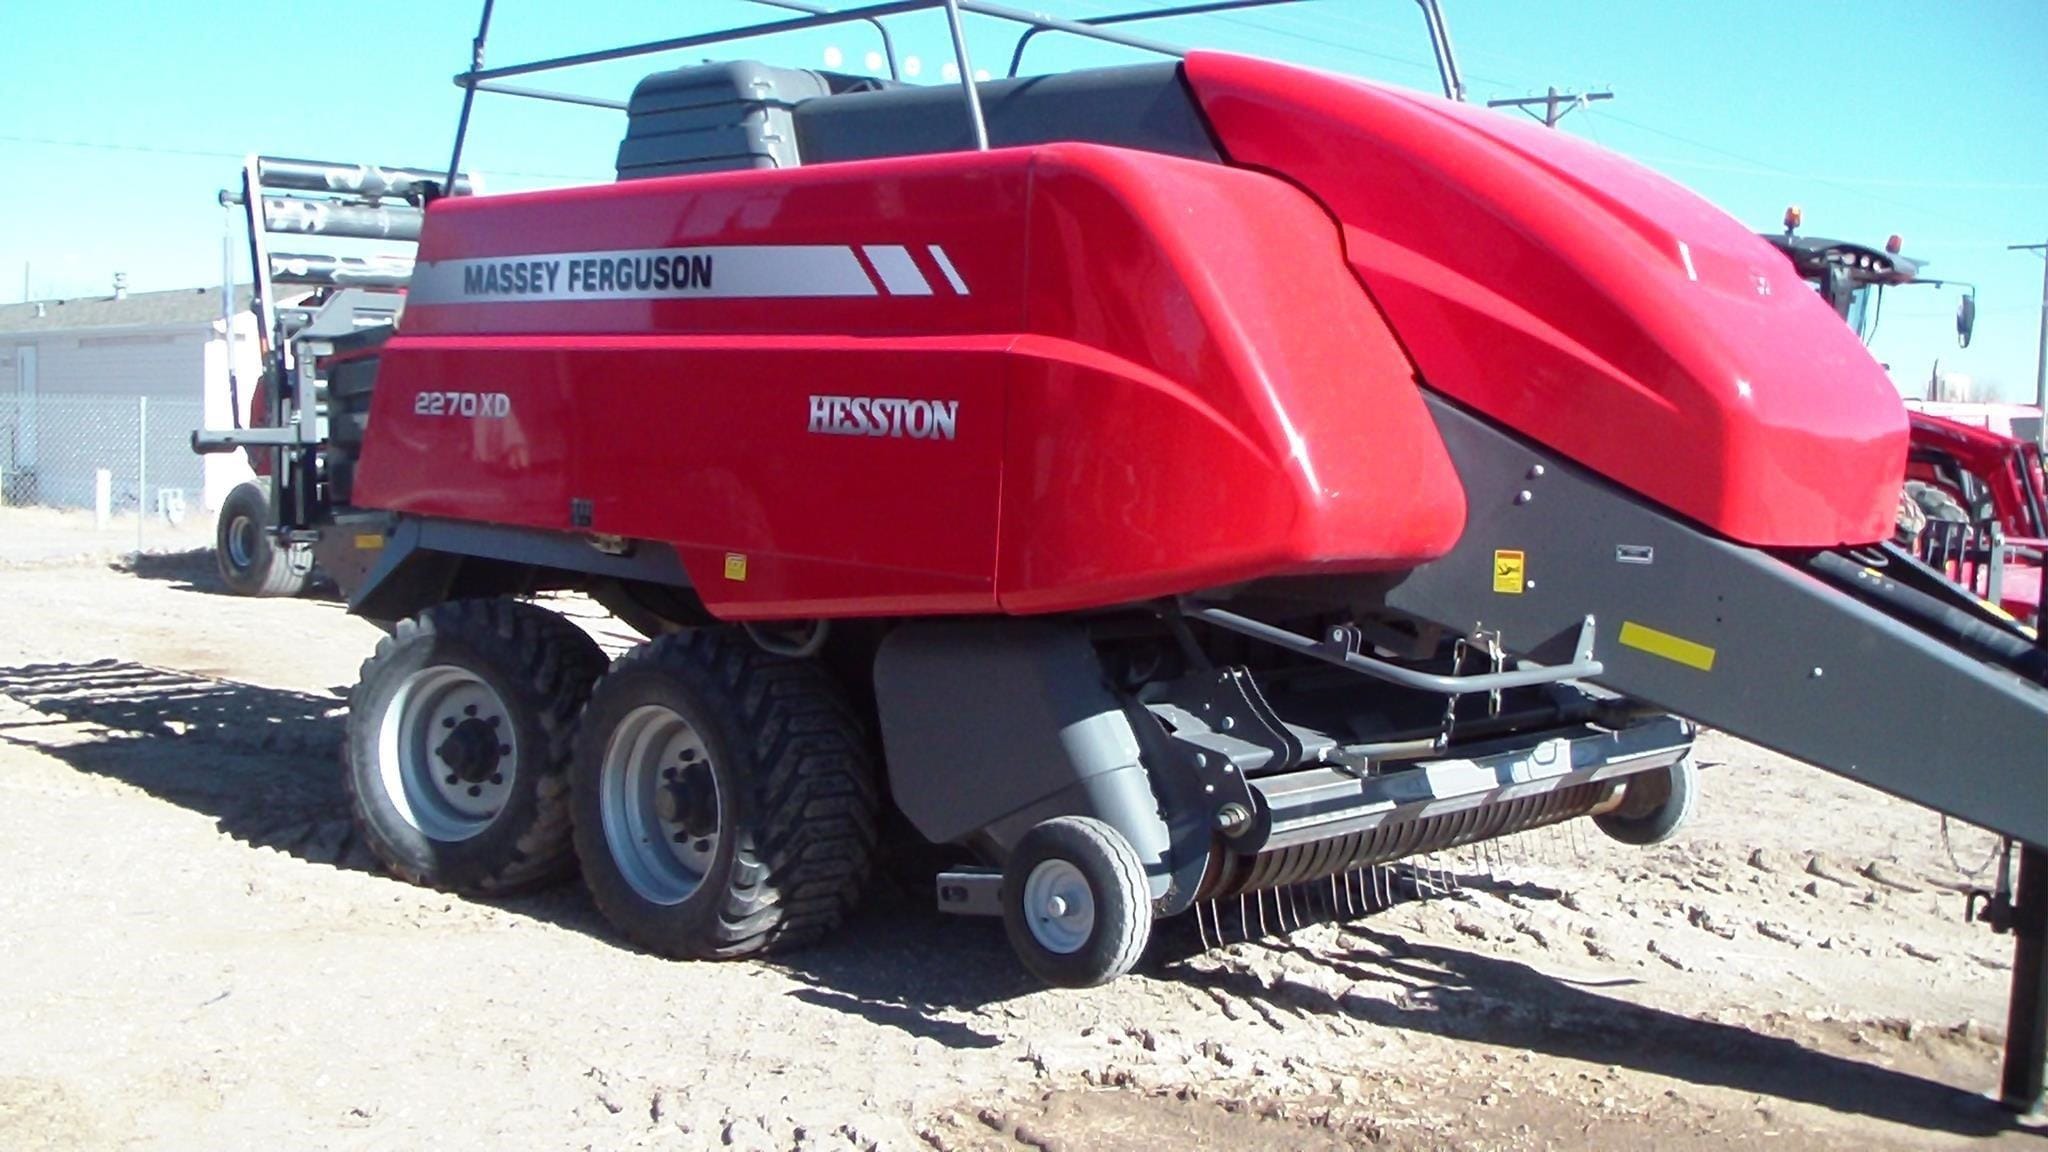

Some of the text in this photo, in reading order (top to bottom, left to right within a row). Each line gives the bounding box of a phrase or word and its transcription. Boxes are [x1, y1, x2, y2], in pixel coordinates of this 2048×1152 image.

[464, 255, 712, 295] MASSEY FERGUSON
[807, 395, 959, 440] HESSTON
